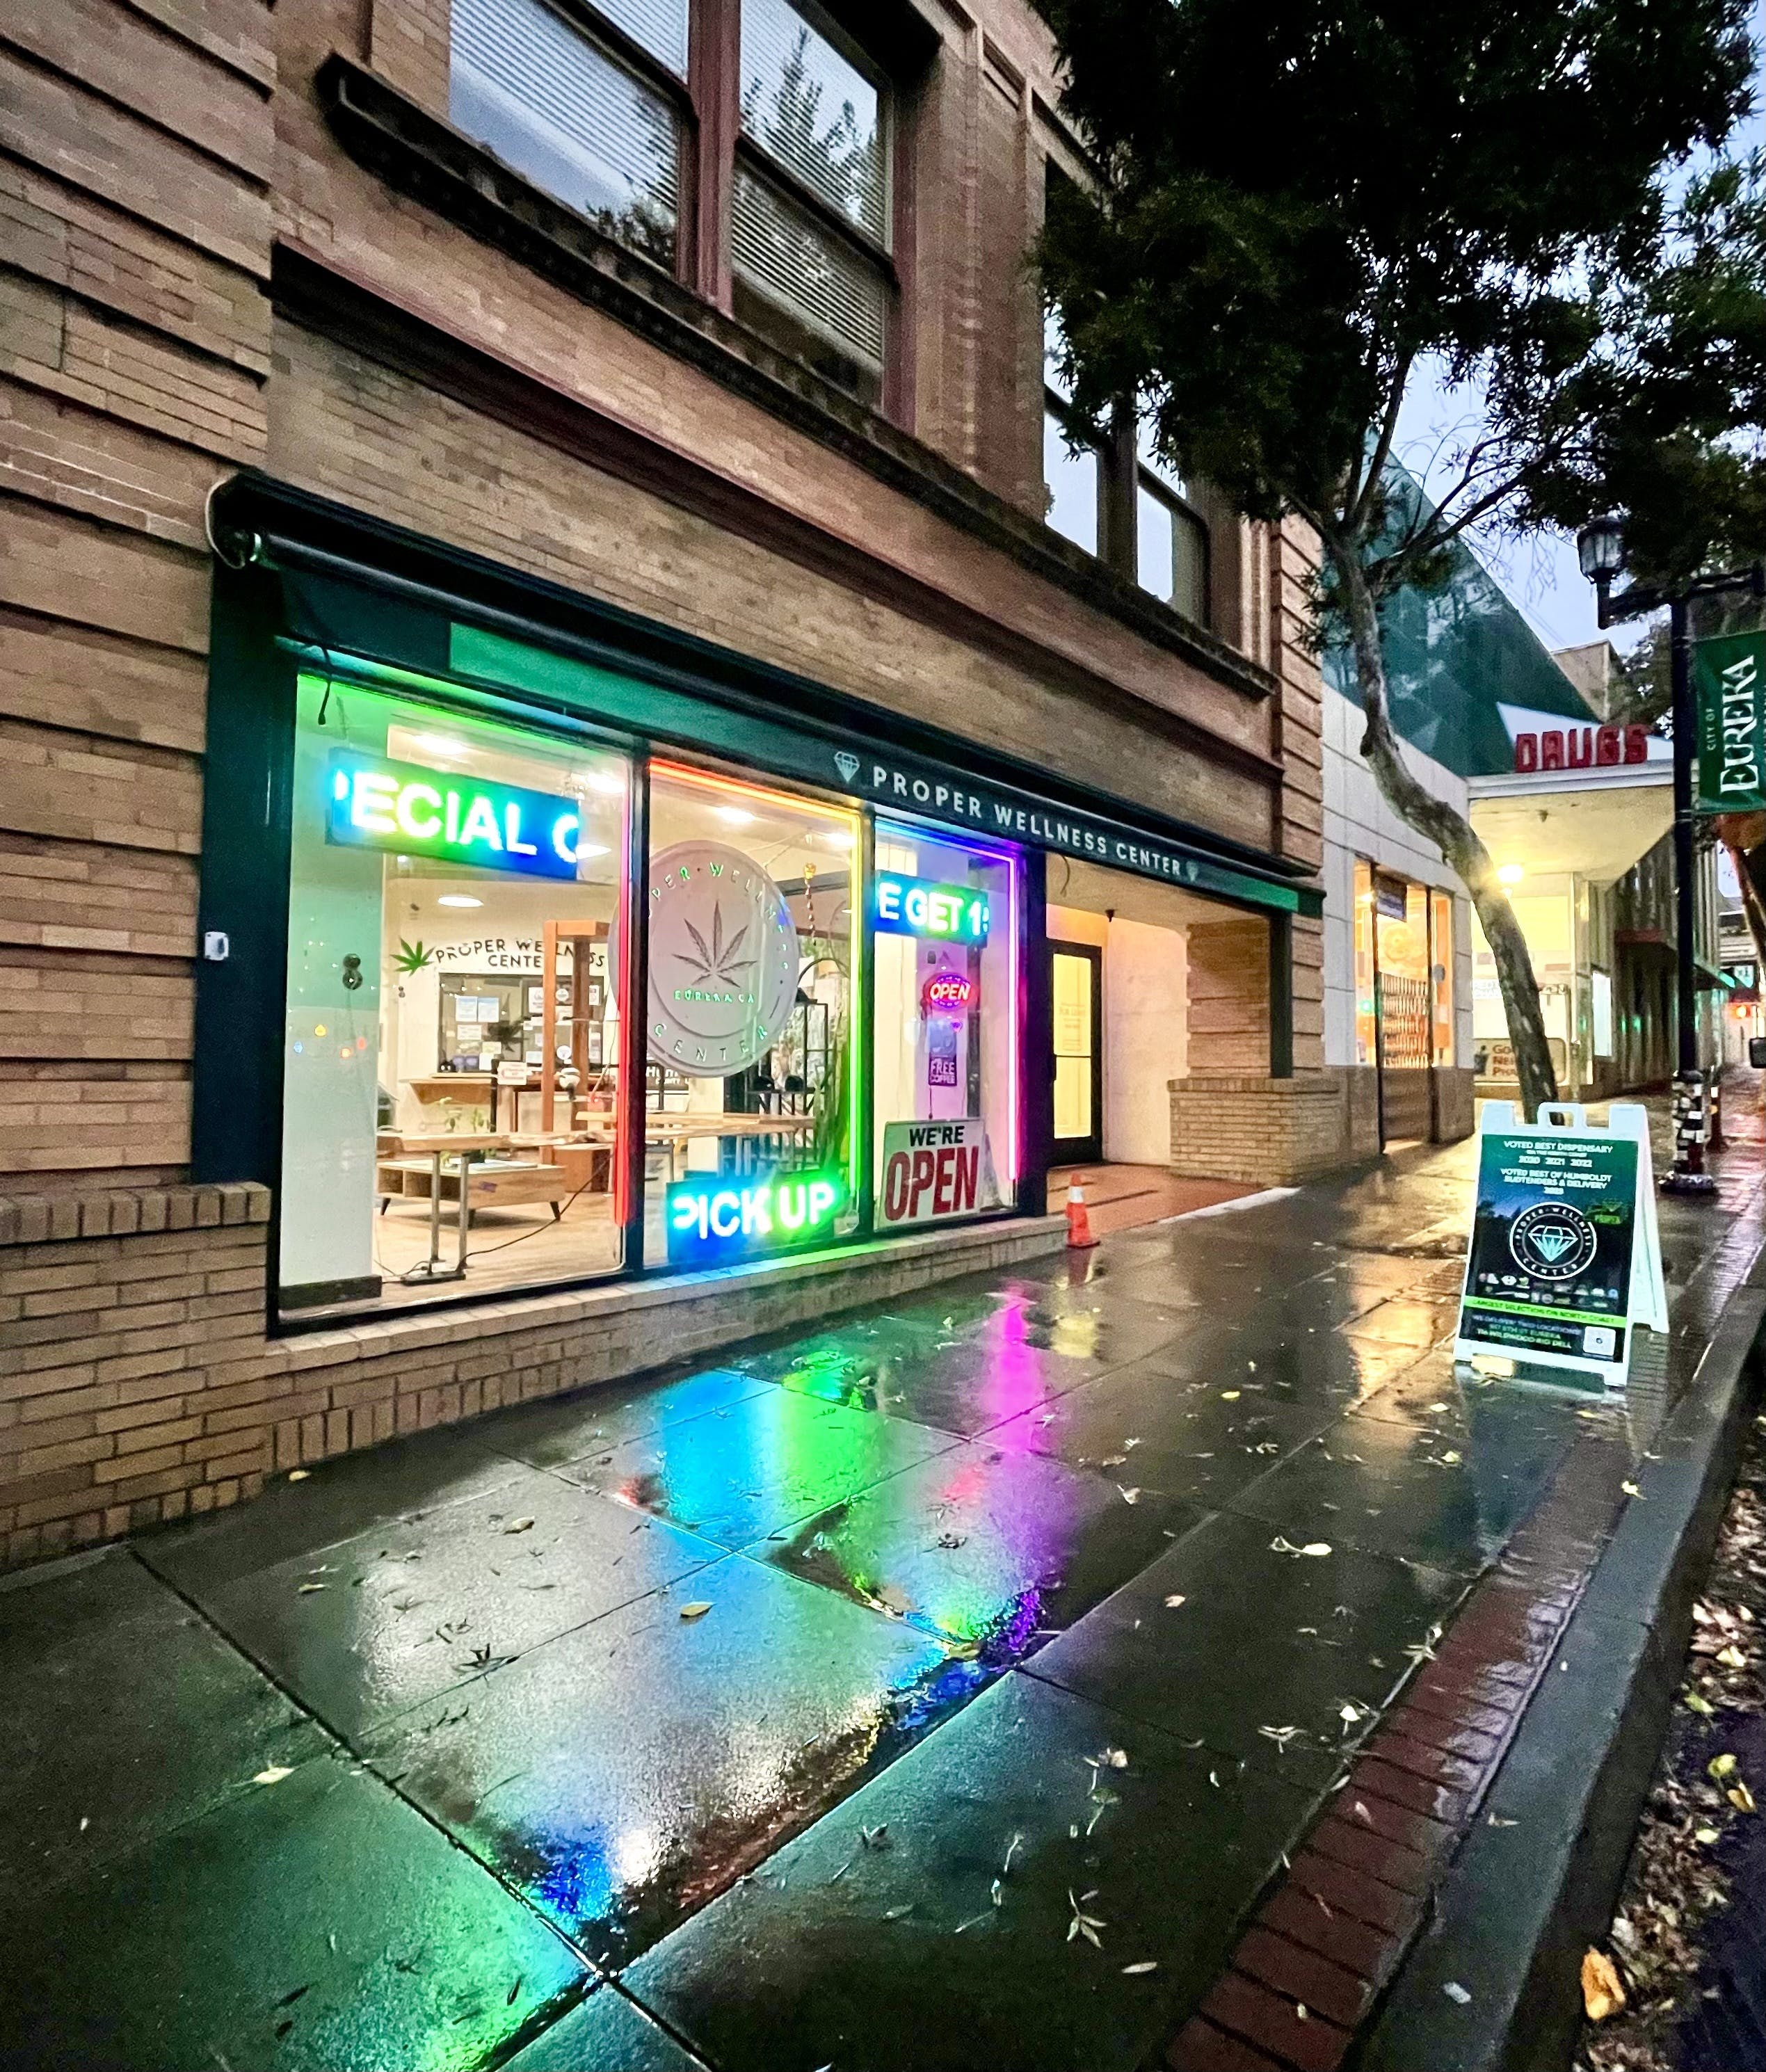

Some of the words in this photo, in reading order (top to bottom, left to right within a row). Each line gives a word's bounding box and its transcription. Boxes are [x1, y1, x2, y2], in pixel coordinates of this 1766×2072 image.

[1705, 708, 1715, 722] OF
[1720, 654, 1759, 794] EUREKA
[1515, 723, 1651, 773] DRUGS
[1706, 728, 1716, 751] CITY
[873, 766, 981, 819] PROPER
[994, 804, 1107, 854] WELLNESS
[1116, 843, 1180, 875] CENTER
[906, 889, 964, 933] GET
[436, 939, 506, 963] PROPER
[488, 954, 541, 967] CENTE
[674, 989, 732, 1003] EUREKA
[738, 994, 755, 1004] CA
[930, 982, 971, 1000] OPEN
[931, 1058, 955, 1075] FREE
[930, 1075, 955, 1084] COFFEE
[910, 1125, 965, 1147] WE'RE
[1504, 1141, 1534, 1149] VOTED
[1557, 1143, 1613, 1153] DISPENSARY
[885, 1146, 979, 1221] OPEN
[1564, 1172, 1612, 1182] HUMBOLDT
[779, 1182, 835, 1229] UP
